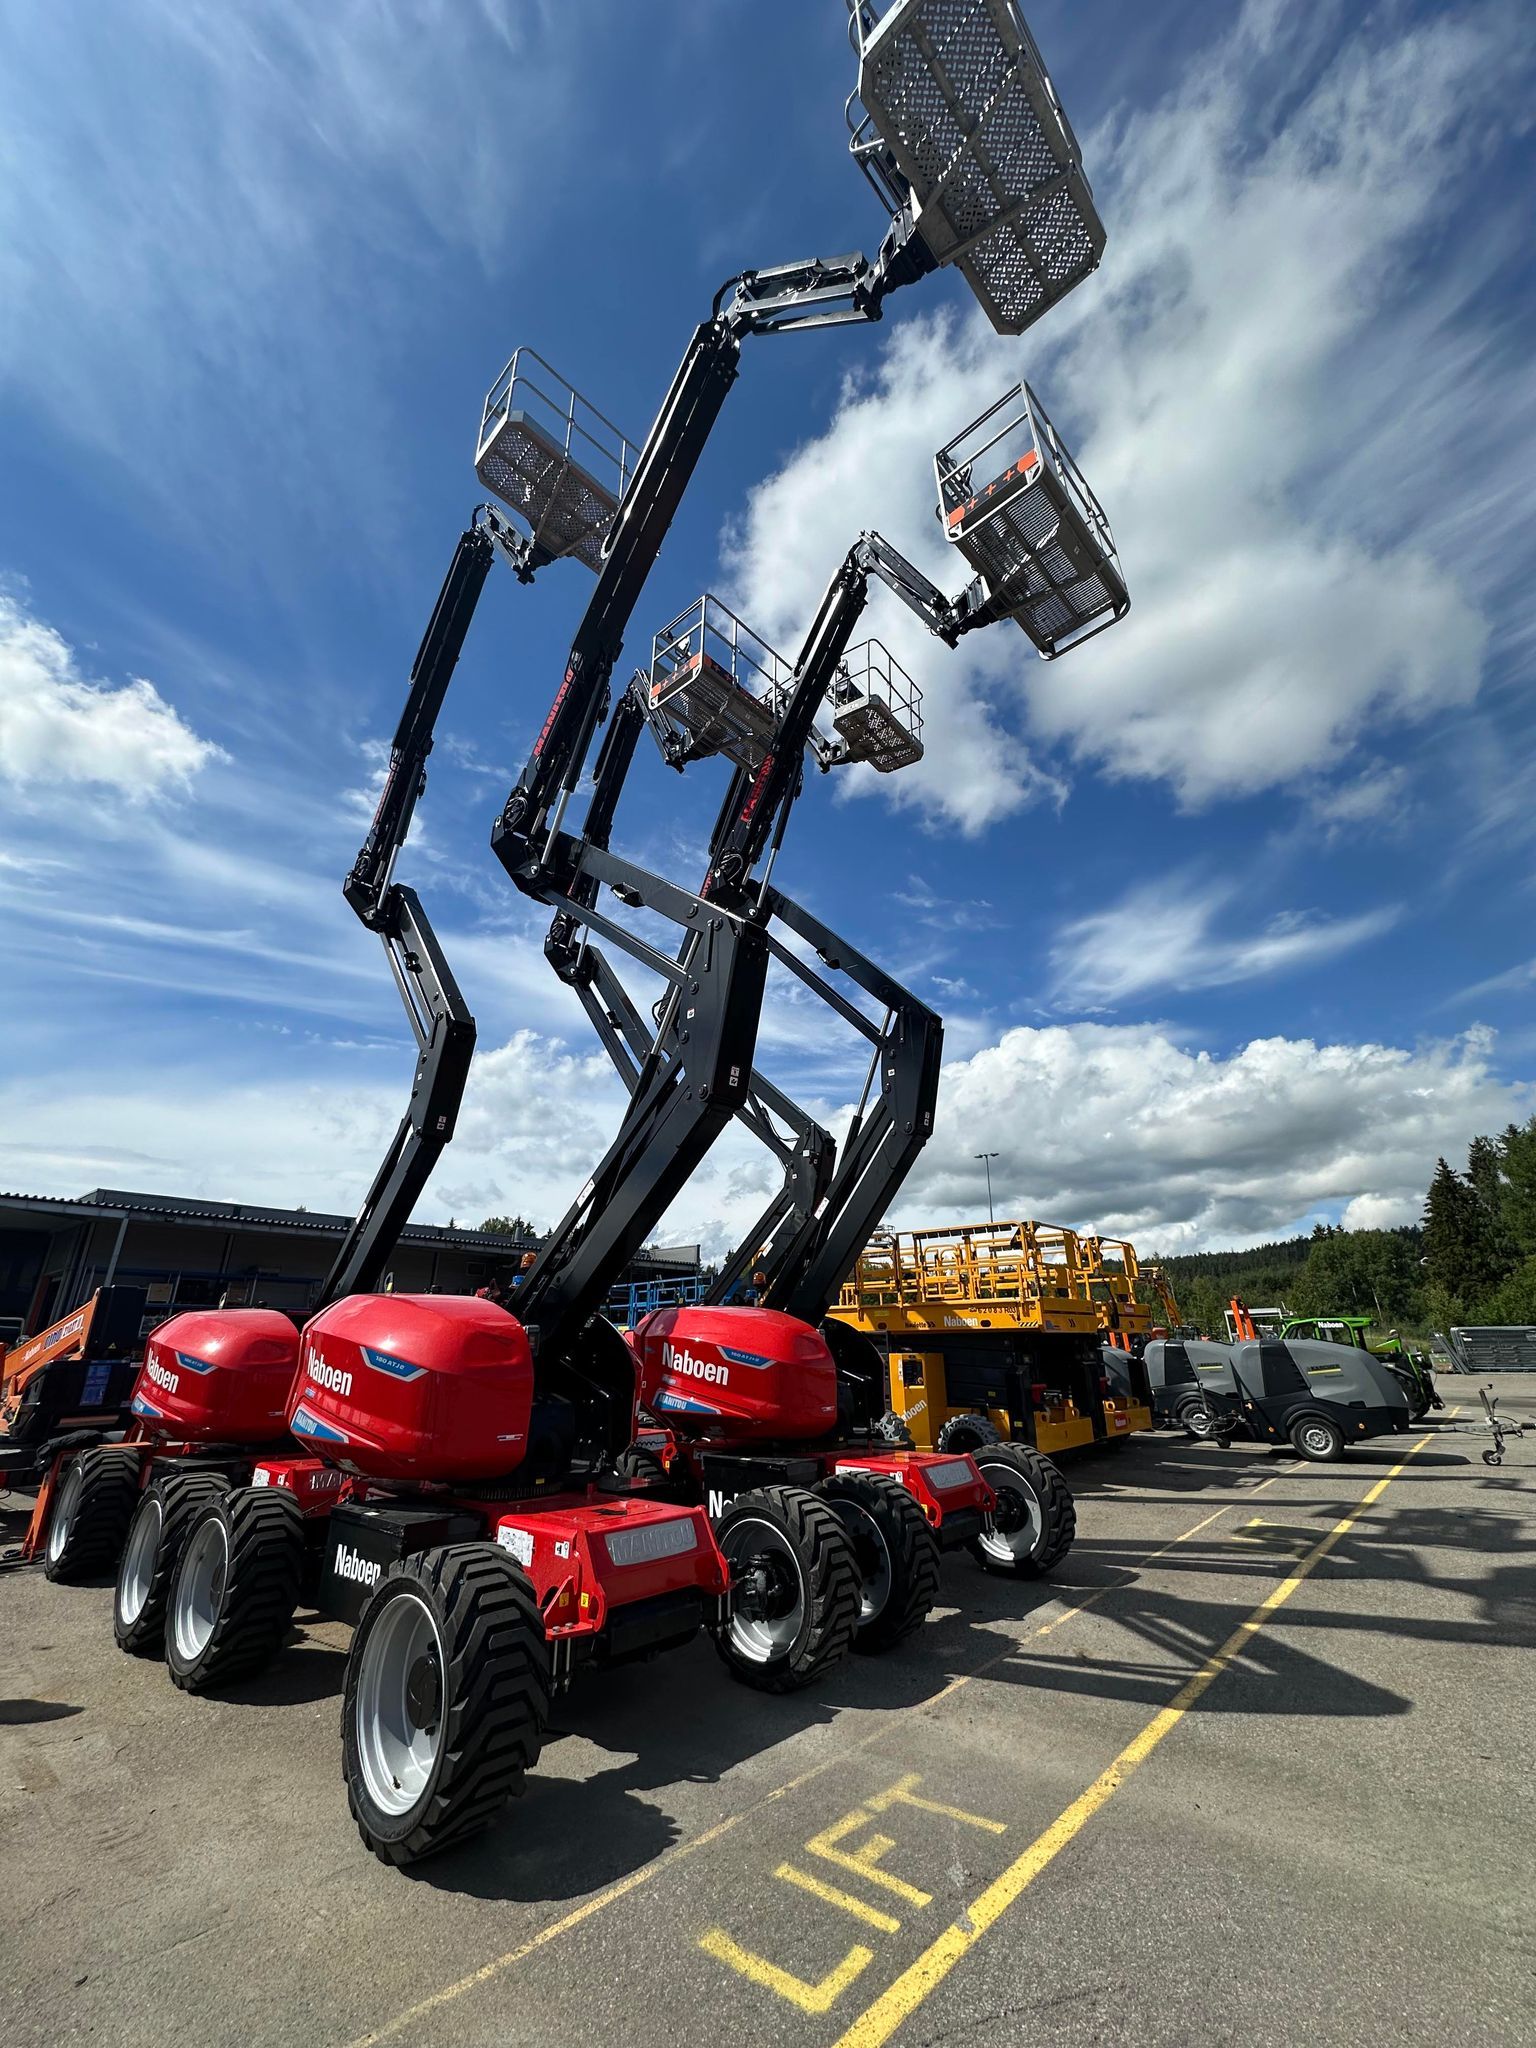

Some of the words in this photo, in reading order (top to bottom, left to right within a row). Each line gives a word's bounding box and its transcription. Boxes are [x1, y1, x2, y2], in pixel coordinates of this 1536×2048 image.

[943, 1315, 979, 1327] Naboen
[1317, 1321, 1344, 1329] Naboen
[147, 1347, 179, 1394] Naboen
[306, 1346, 353, 1396] Naboen
[662, 1342, 729, 1386] Naboen
[901, 1399, 928, 1421] aboen
[698, 1771, 1008, 2014] LIFT
